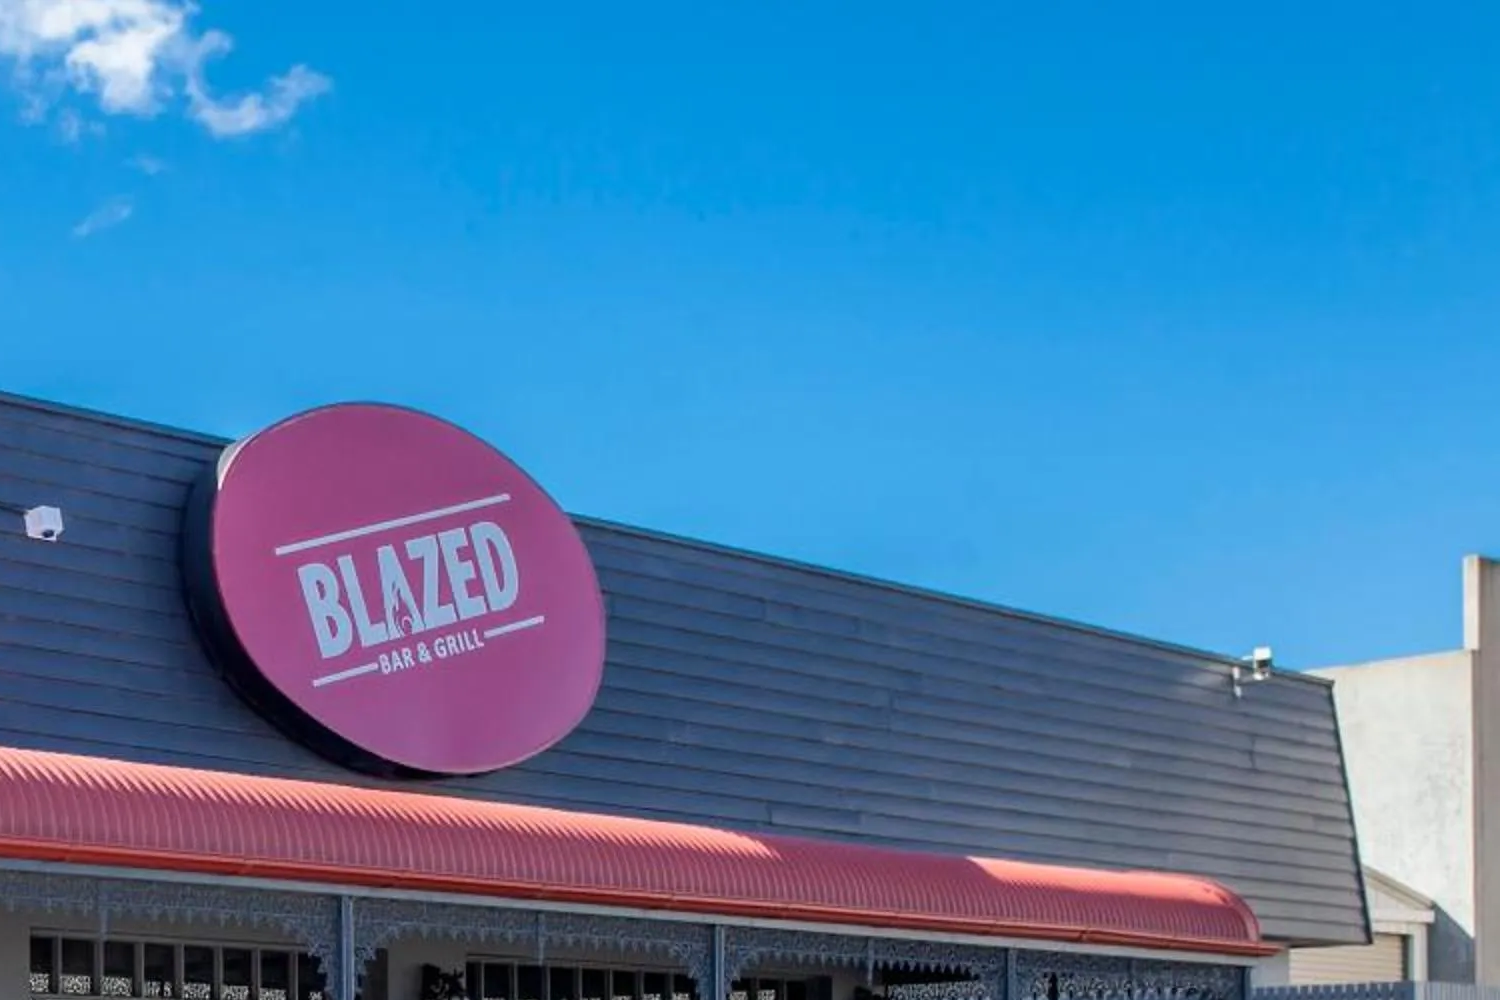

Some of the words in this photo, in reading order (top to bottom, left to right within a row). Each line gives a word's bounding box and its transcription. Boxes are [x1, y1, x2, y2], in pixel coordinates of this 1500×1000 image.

[298, 521, 520, 659] BLAZED
[379, 647, 415, 675] BAR
[417, 641, 432, 664] &
[434, 628, 485, 659] GRILL
